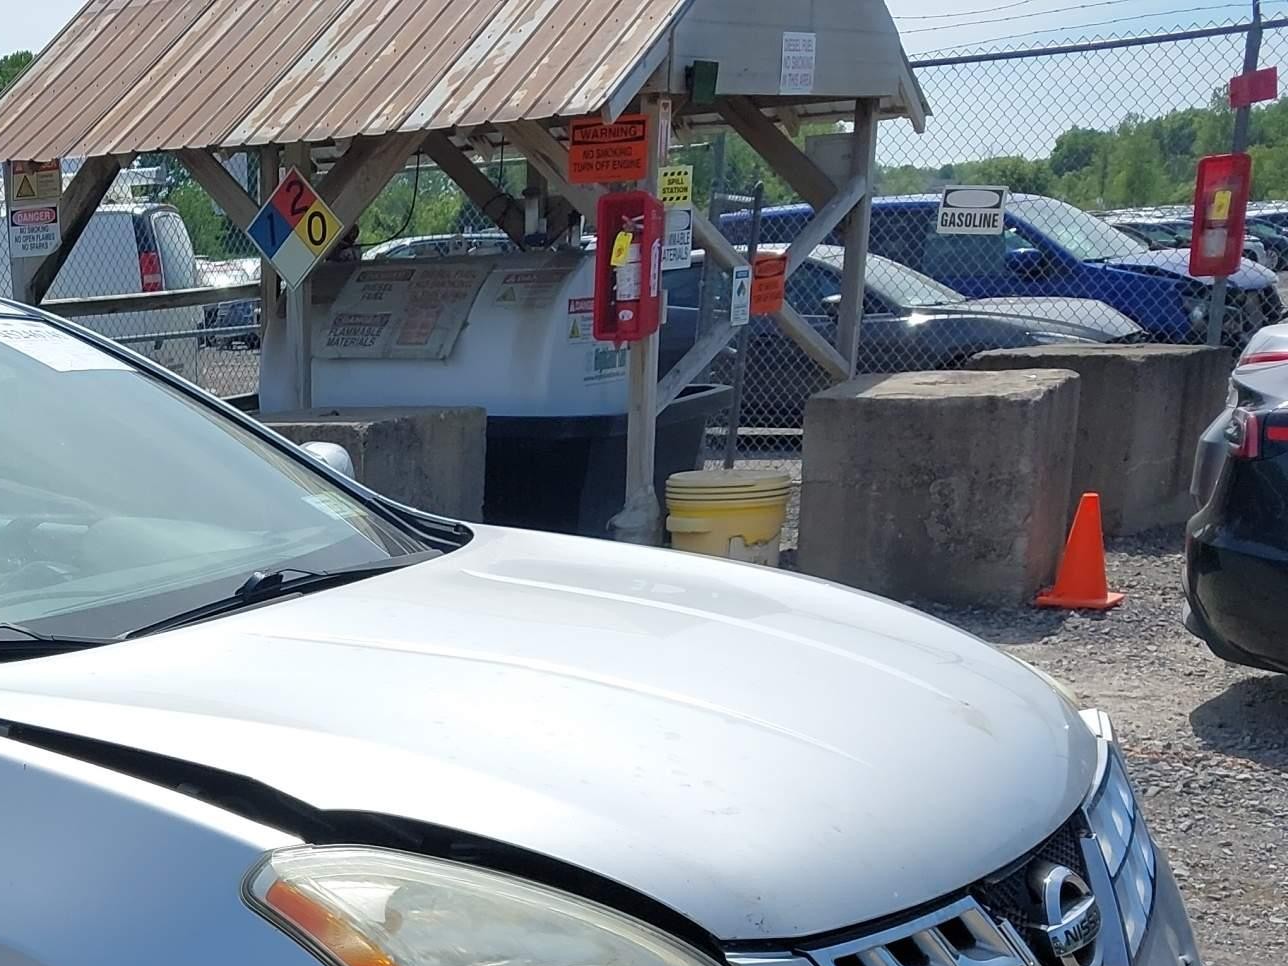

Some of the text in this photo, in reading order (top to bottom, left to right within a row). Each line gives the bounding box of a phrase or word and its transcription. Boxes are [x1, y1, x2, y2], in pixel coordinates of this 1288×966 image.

[580, 126, 637, 140] WARNING
[583, 146, 633, 159] NO SMOKING
[573, 158, 641, 172] TURN OFF ENGINE
[667, 178, 684, 186] SPILL
[662, 186, 688, 195] STATION
[285, 180, 310, 216] 2
[17, 211, 51, 224] DANGER
[940, 212, 999, 228] GASOLINE
[267, 210, 327, 247] 1 0
[663, 246, 688, 262] ATERIALS
[328, 327, 383, 337] FLAMMABLE
[326, 337, 376, 347] MATERIALS
